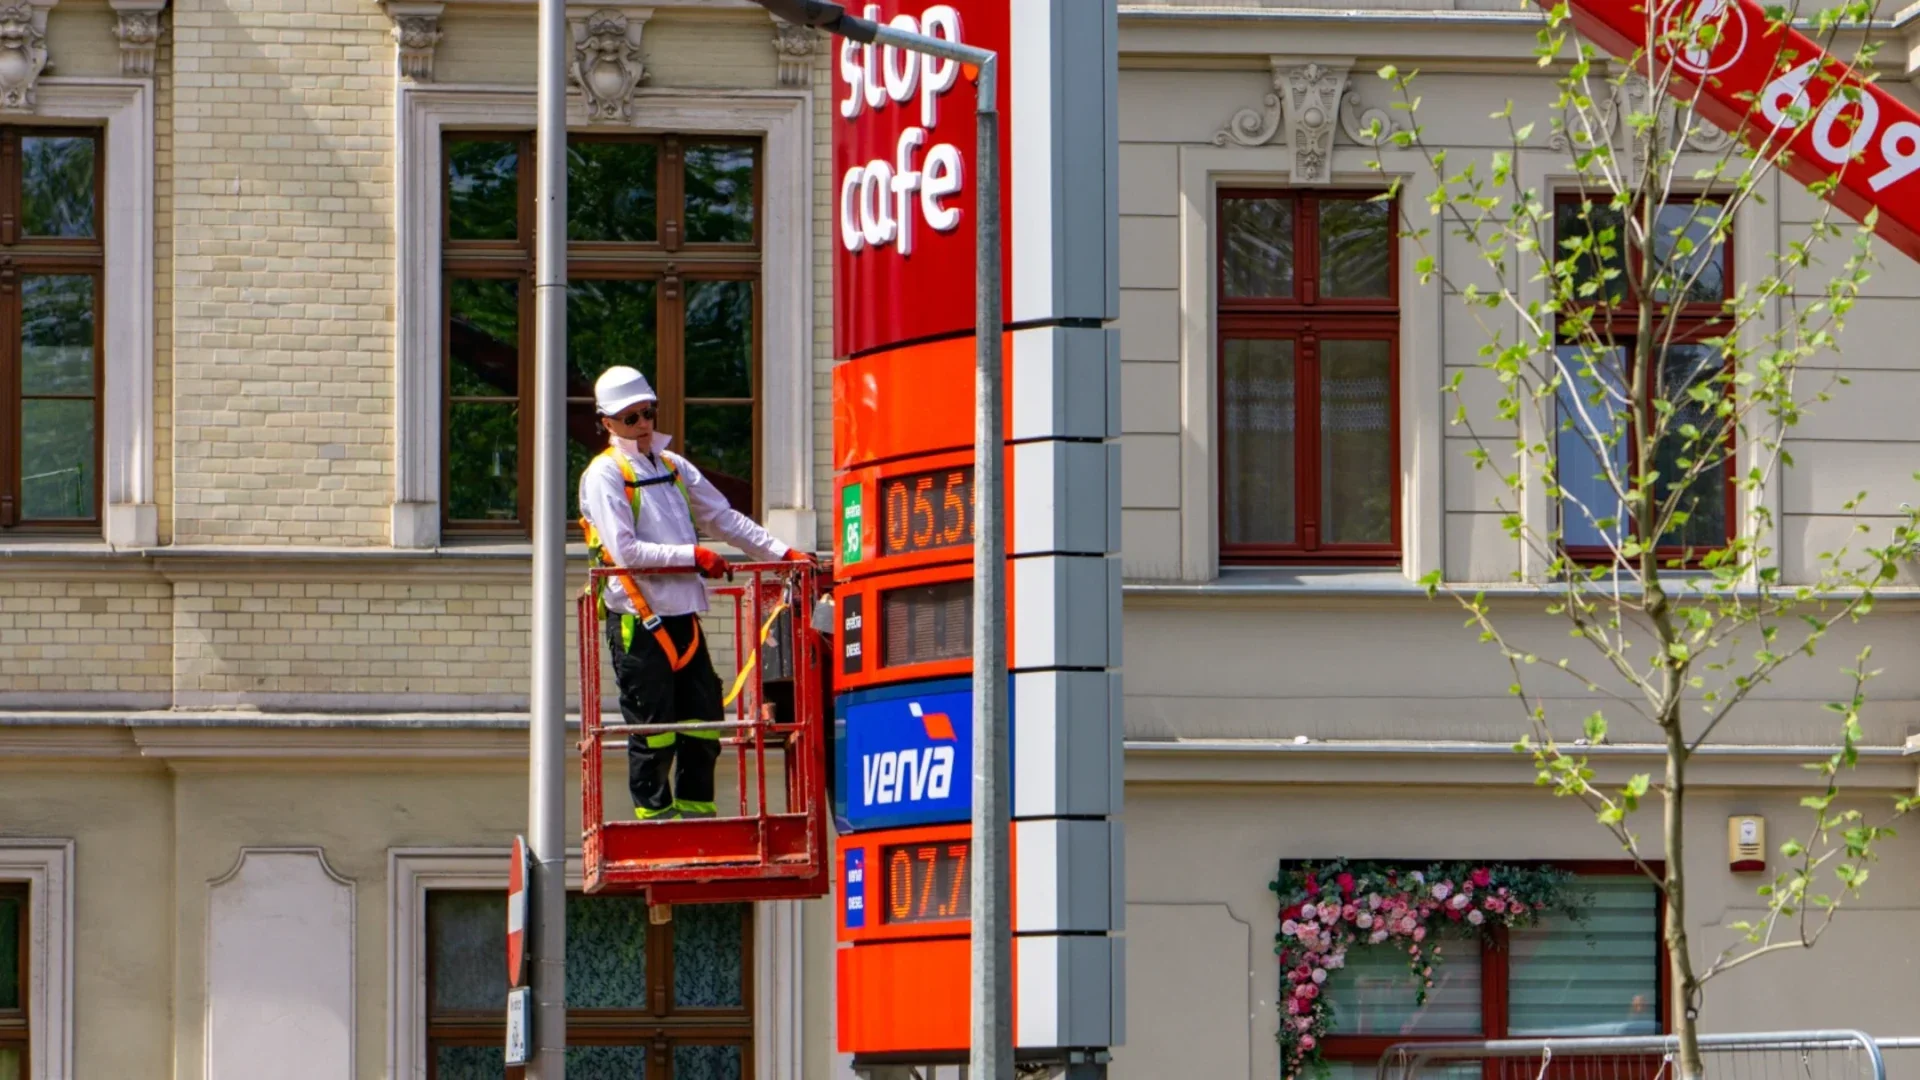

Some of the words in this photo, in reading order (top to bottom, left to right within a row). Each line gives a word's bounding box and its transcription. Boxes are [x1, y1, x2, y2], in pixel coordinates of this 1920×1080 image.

[841, 4, 962, 128] stop
[1761, 57, 1920, 192] 609
[841, 127, 963, 255] cafe
[887, 472, 975, 550] 05.5
[863, 746, 955, 806] verva
